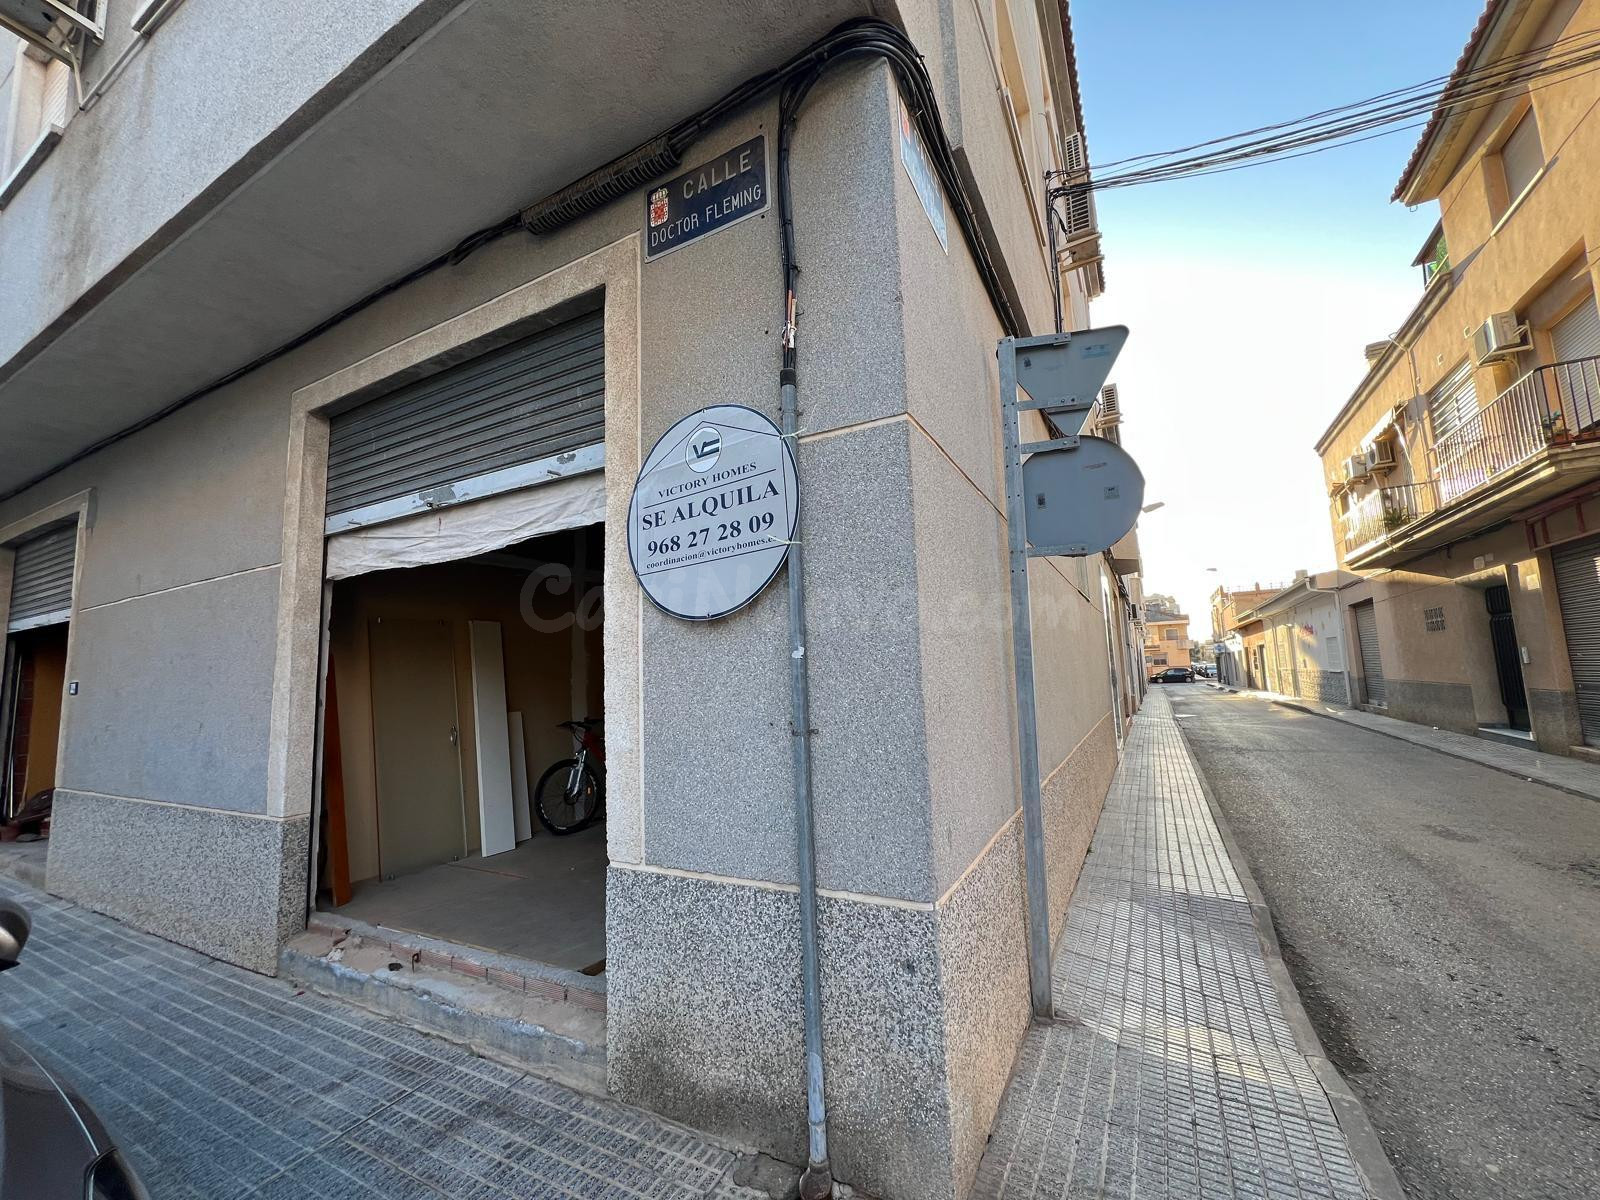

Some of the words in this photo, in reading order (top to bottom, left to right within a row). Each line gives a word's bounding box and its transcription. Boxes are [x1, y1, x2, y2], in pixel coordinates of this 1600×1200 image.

[682, 149, 752, 200] CALLE
[651, 213, 699, 247] DOCTOR
[705, 184, 761, 223] FLEMING
[642, 509, 667, 531] SE
[671, 479, 780, 524] ALQUILA
[658, 475, 709, 499] VICTORY
[712, 461, 757, 482] HOMES
[647, 535, 681, 558] 968
[687, 527, 710, 549] 27
[717, 520, 742, 542] 28
[748, 511, 775, 534] 09
